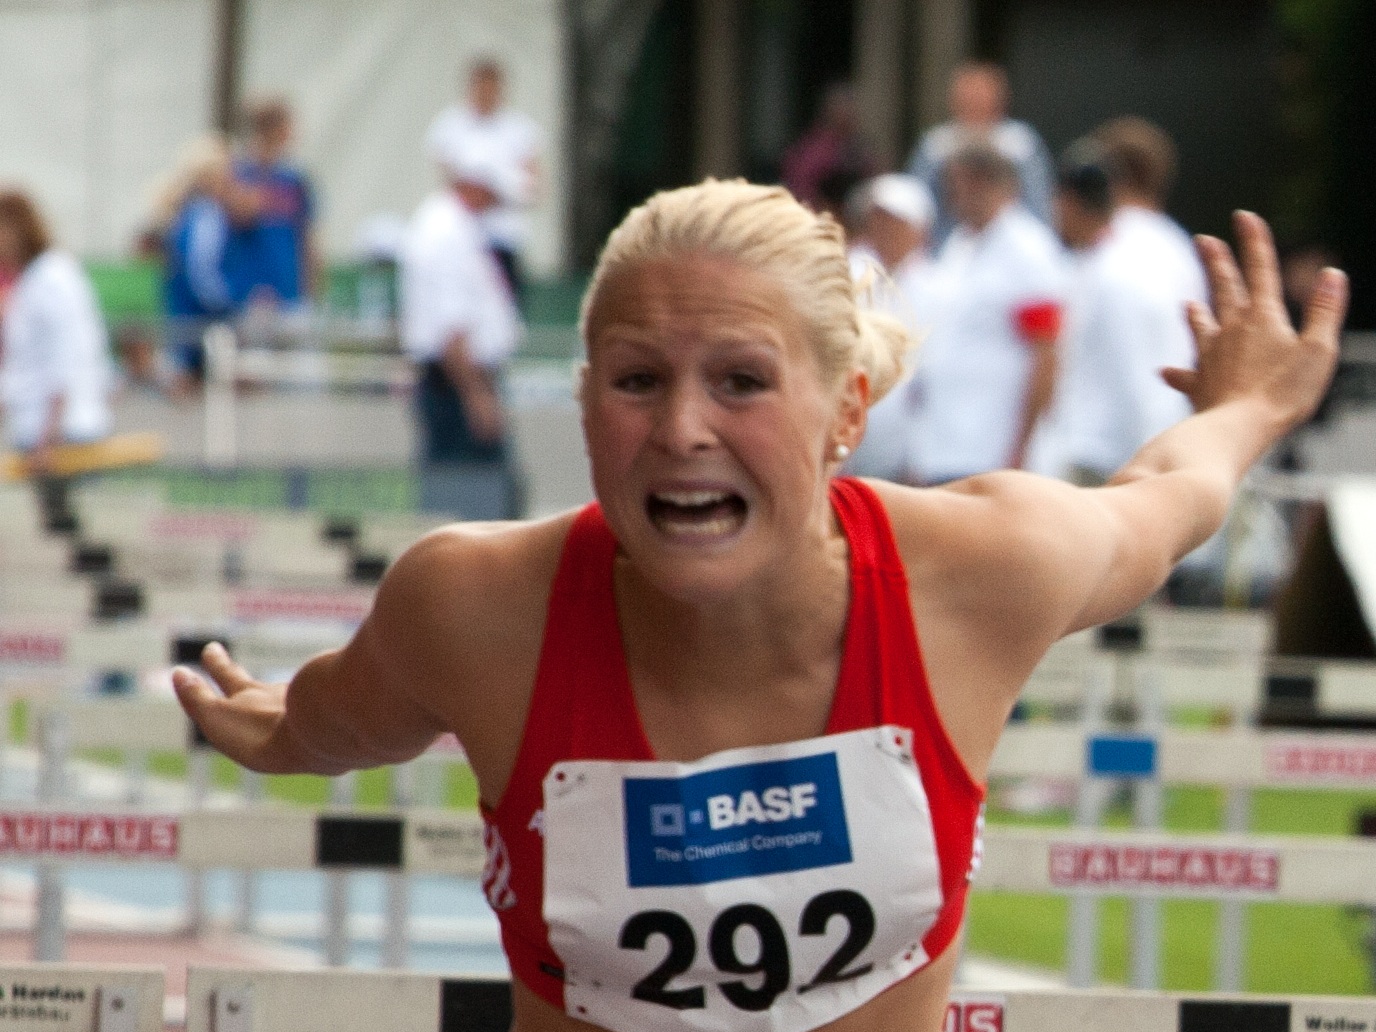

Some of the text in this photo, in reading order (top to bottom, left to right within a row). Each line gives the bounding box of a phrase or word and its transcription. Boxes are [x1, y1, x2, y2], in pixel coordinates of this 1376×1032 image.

[707, 783, 817, 831] BASF
[654, 828, 823, 862] The Chemical Company
[618, 889, 875, 1012] 292
